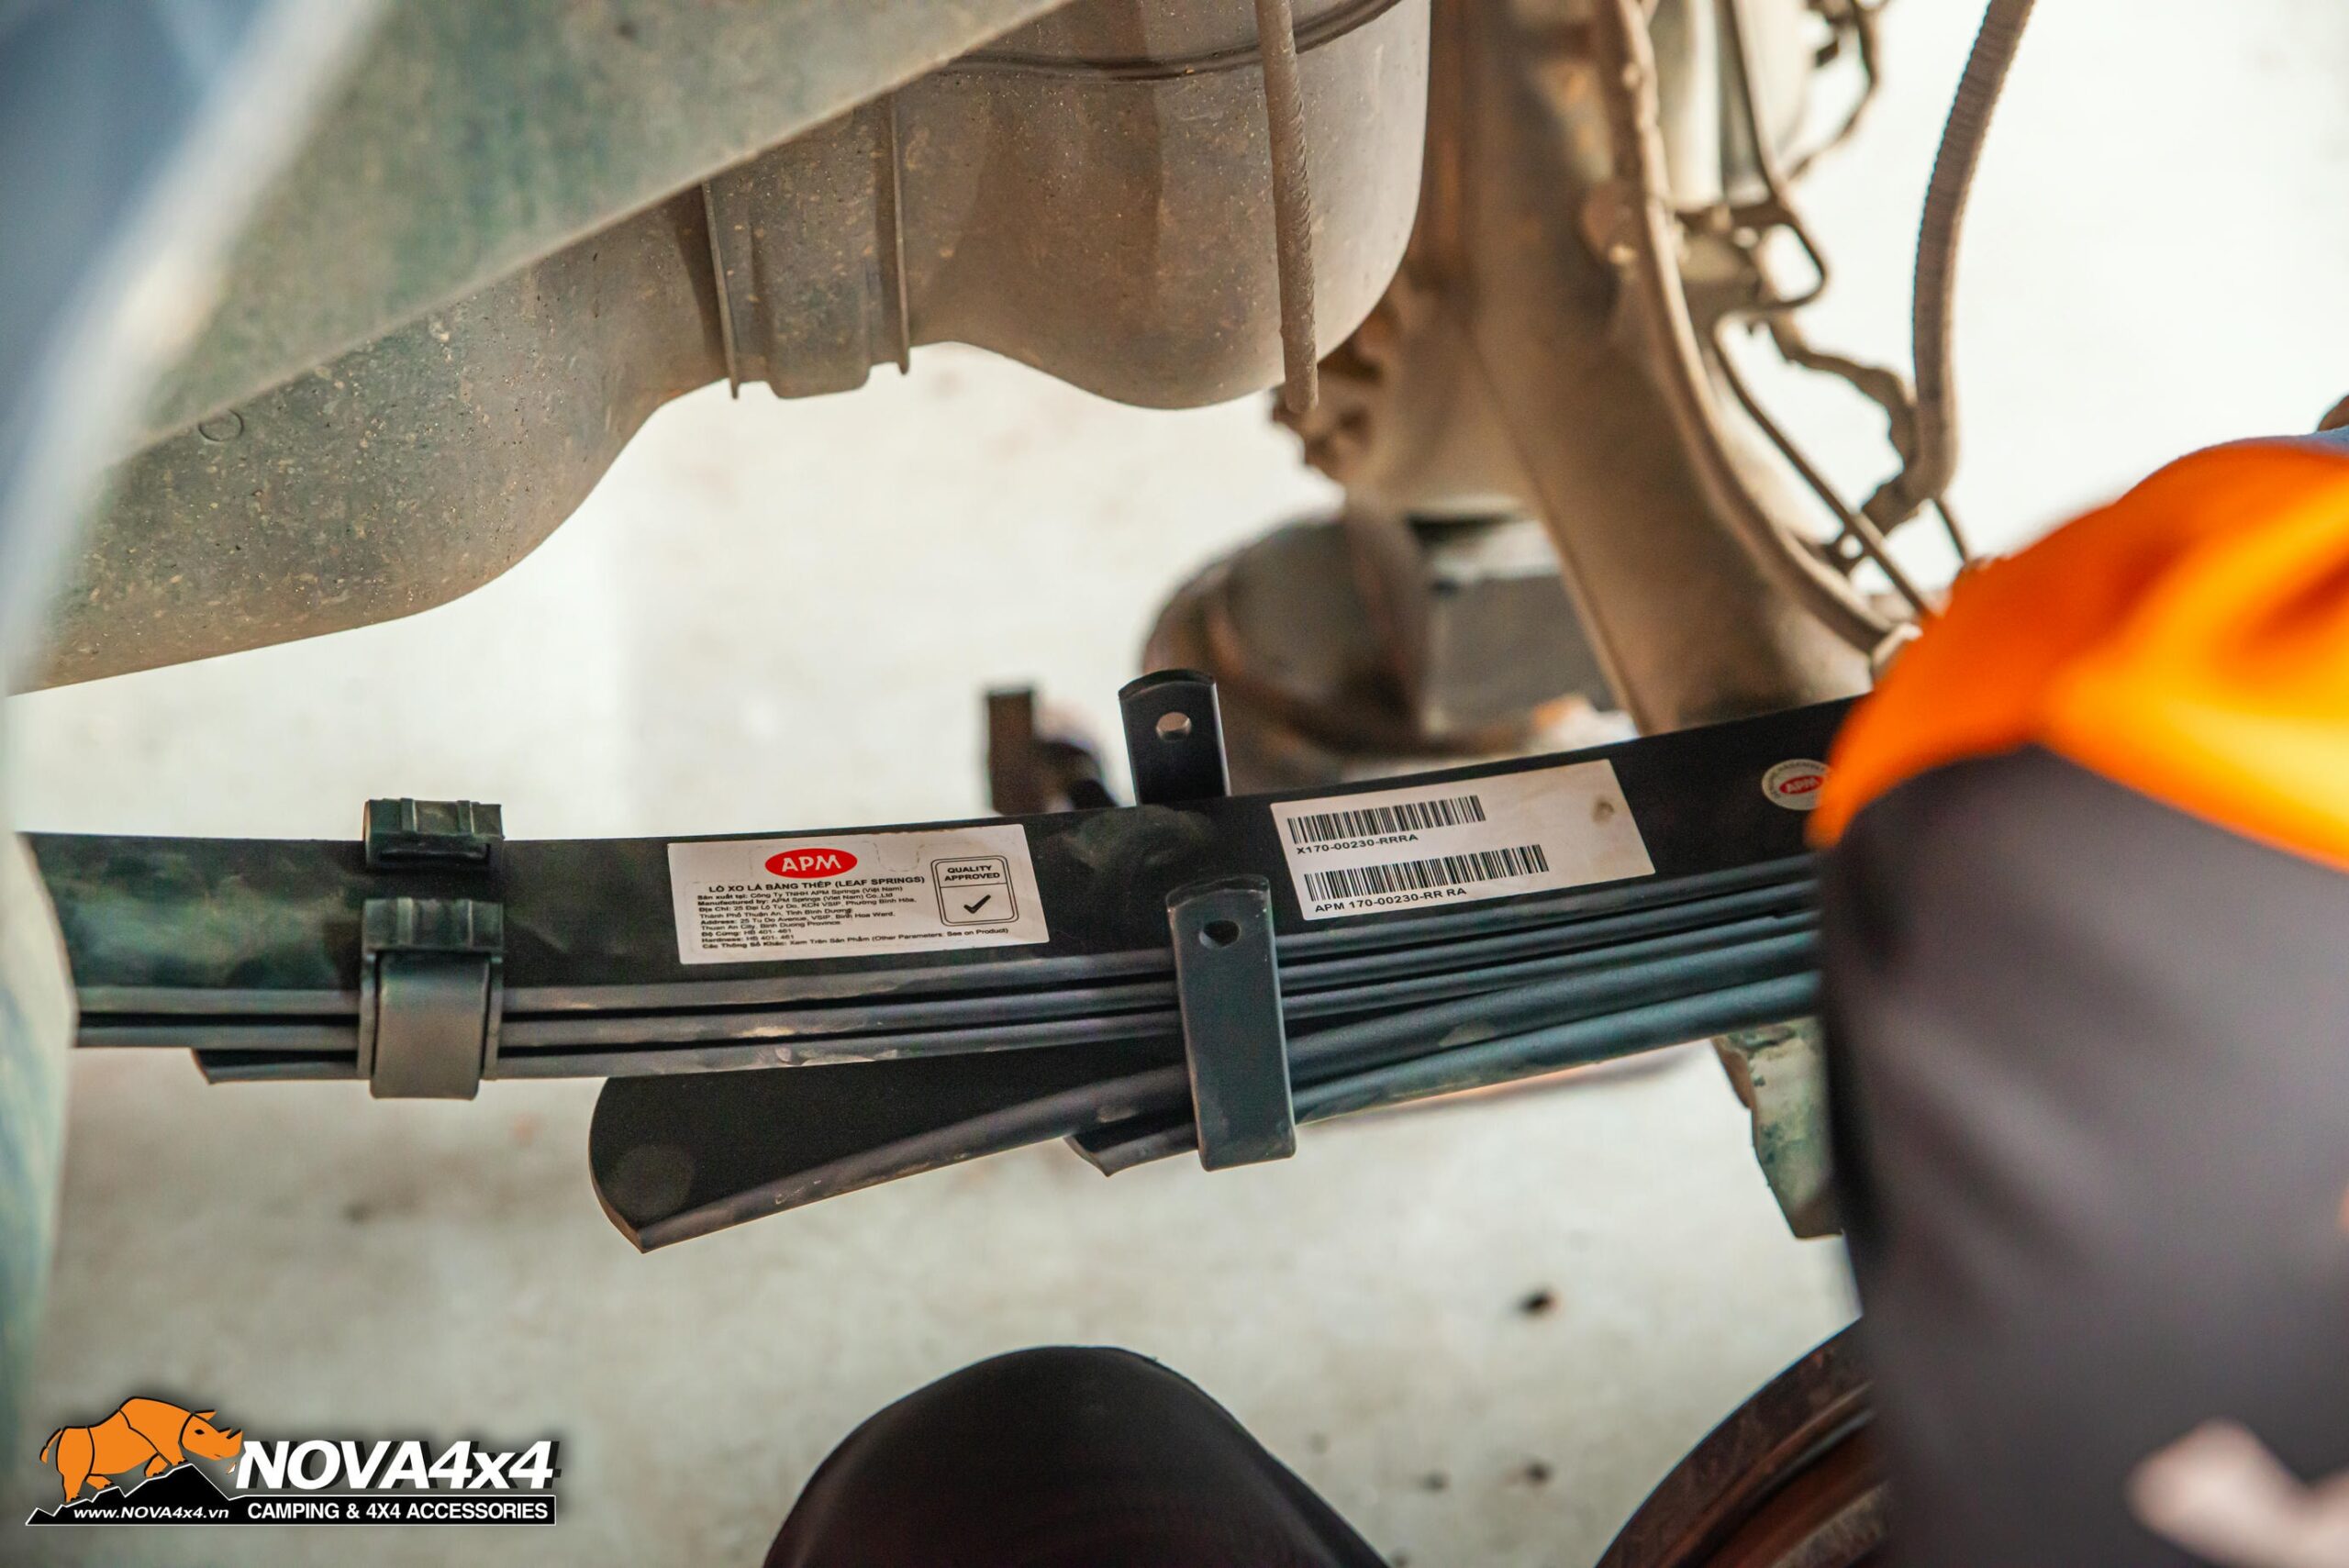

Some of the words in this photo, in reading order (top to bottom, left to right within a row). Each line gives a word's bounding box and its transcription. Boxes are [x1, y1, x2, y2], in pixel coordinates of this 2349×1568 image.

[1297, 834, 1419, 855] X170-00230-RRRA
[782, 855, 841, 873] APM
[947, 865, 992, 873] QUALITY
[835, 879, 867, 888] (LEAF
[871, 876, 924, 885] SPRINGS)
[944, 873, 1000, 881] APPROVED
[1315, 901, 1345, 912] APM
[1349, 890, 1442, 909] 170-00230-RR
[1447, 887, 1467, 896] RA
